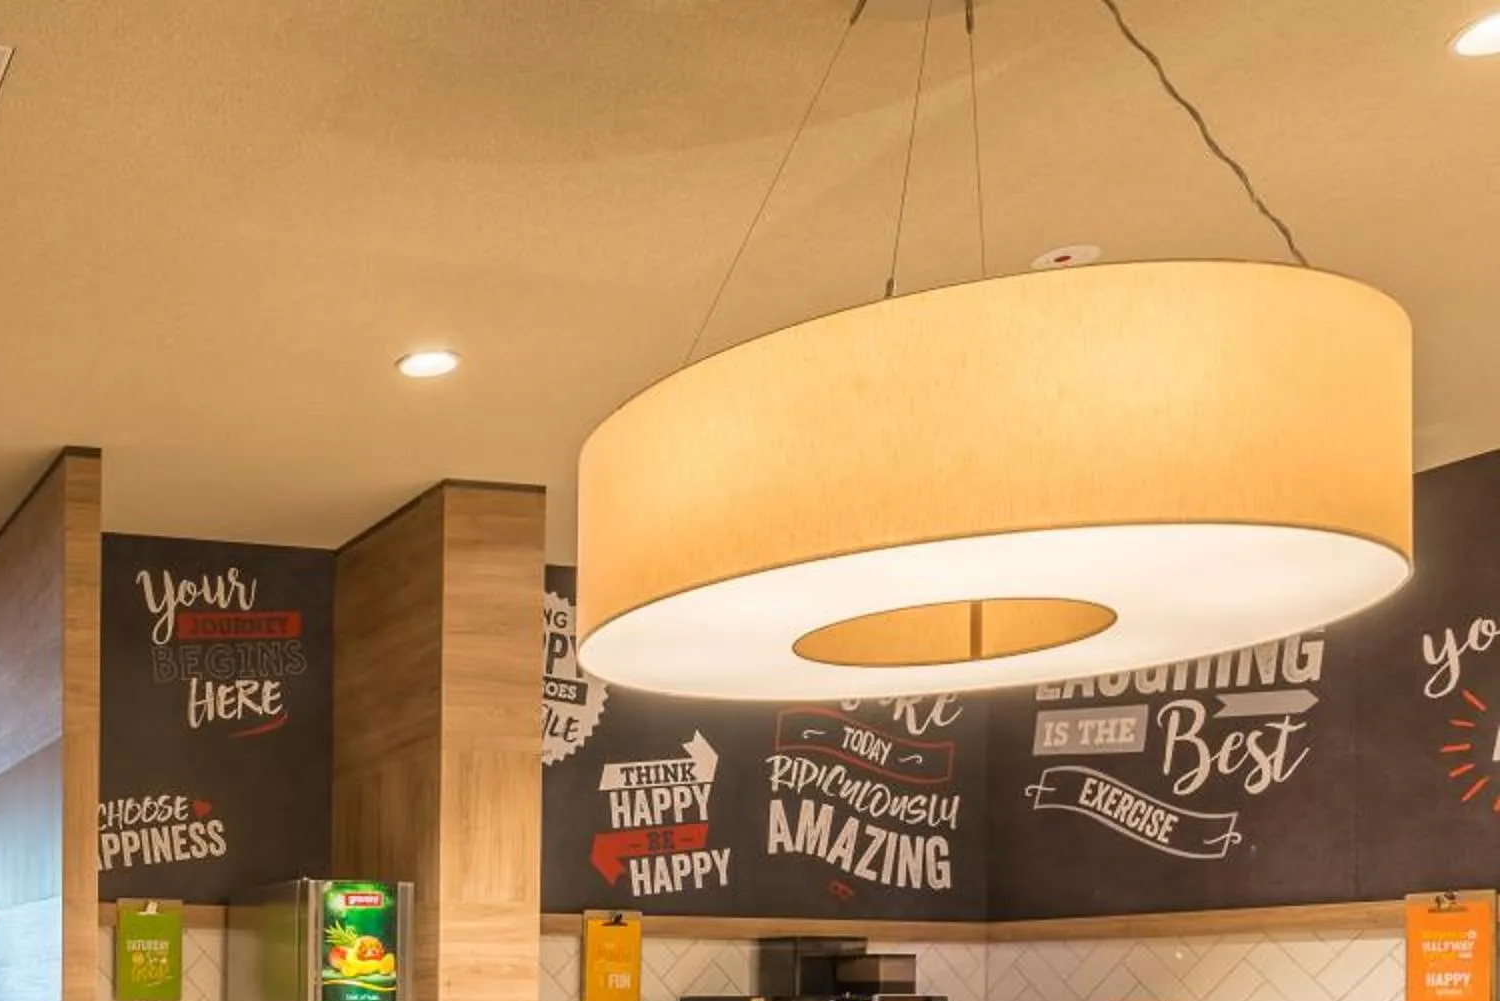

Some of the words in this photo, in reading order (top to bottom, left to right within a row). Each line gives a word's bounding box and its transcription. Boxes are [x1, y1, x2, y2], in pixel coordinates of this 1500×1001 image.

[135, 566, 257, 645] Your
[151, 639, 308, 683] BEGINS
[187, 676, 284, 729] HERE
[841, 726, 893, 766] TODAY
[1043, 720, 1068, 747] IS
[1078, 717, 1137, 746] THE
[1157, 699, 1310, 795] Best
[620, 761, 697, 786] THINK
[765, 755, 961, 830] RIDICULOUSLY
[98, 795, 189, 830] CHOOSE
[609, 783, 711, 829] HAPPY
[1079, 777, 1180, 844] EXERCISE
[98, 819, 227, 871] PPINESS
[647, 830, 676, 852] BE
[767, 799, 952, 889] AMAZING
[629, 847, 731, 897] HAPPY
[1425, 971, 1472, 987] HAPPY
